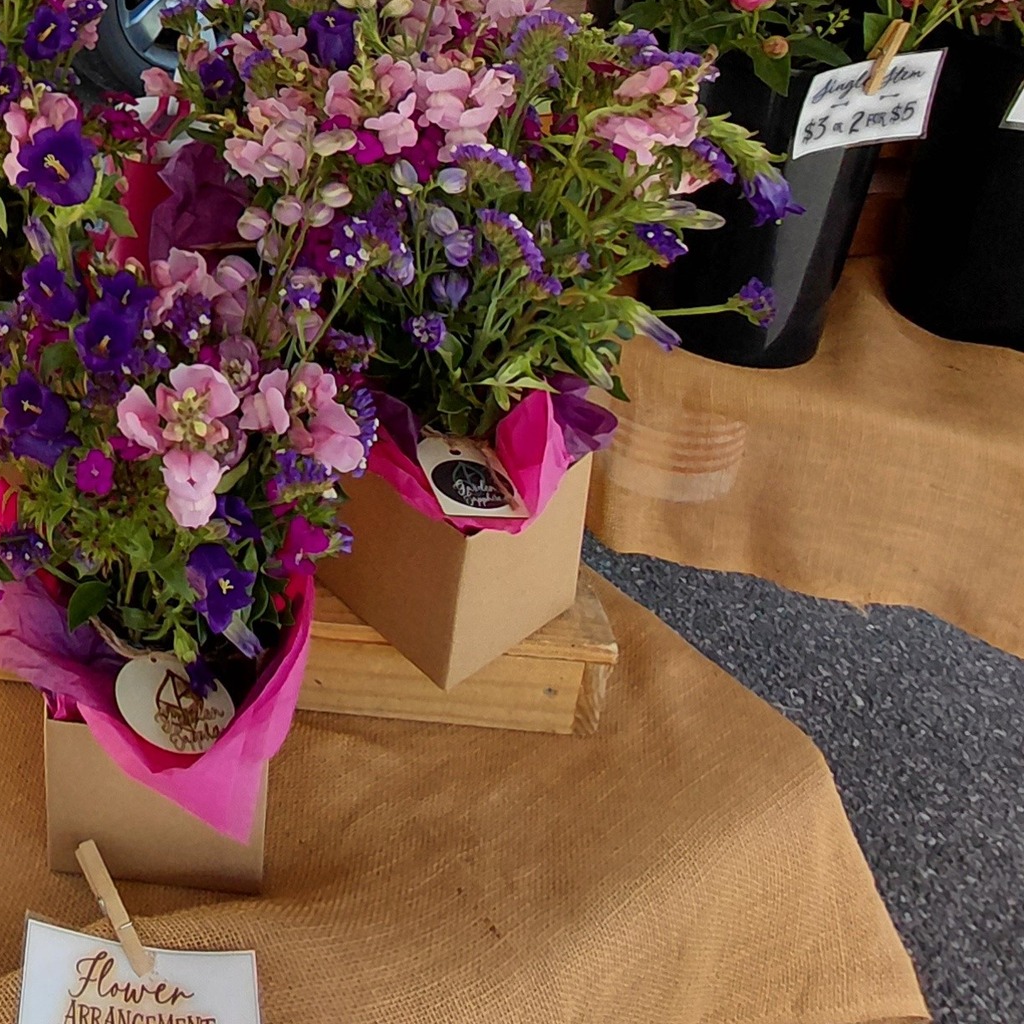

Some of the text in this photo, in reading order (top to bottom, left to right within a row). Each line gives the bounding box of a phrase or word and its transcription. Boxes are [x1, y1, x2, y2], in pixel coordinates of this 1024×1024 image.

[812, 69, 869, 104] Singl
[802, 115, 830, 144] $3
[848, 110, 865, 134] 2
[889, 100, 917, 125] $5
[67, 950, 195, 1005] Flower
